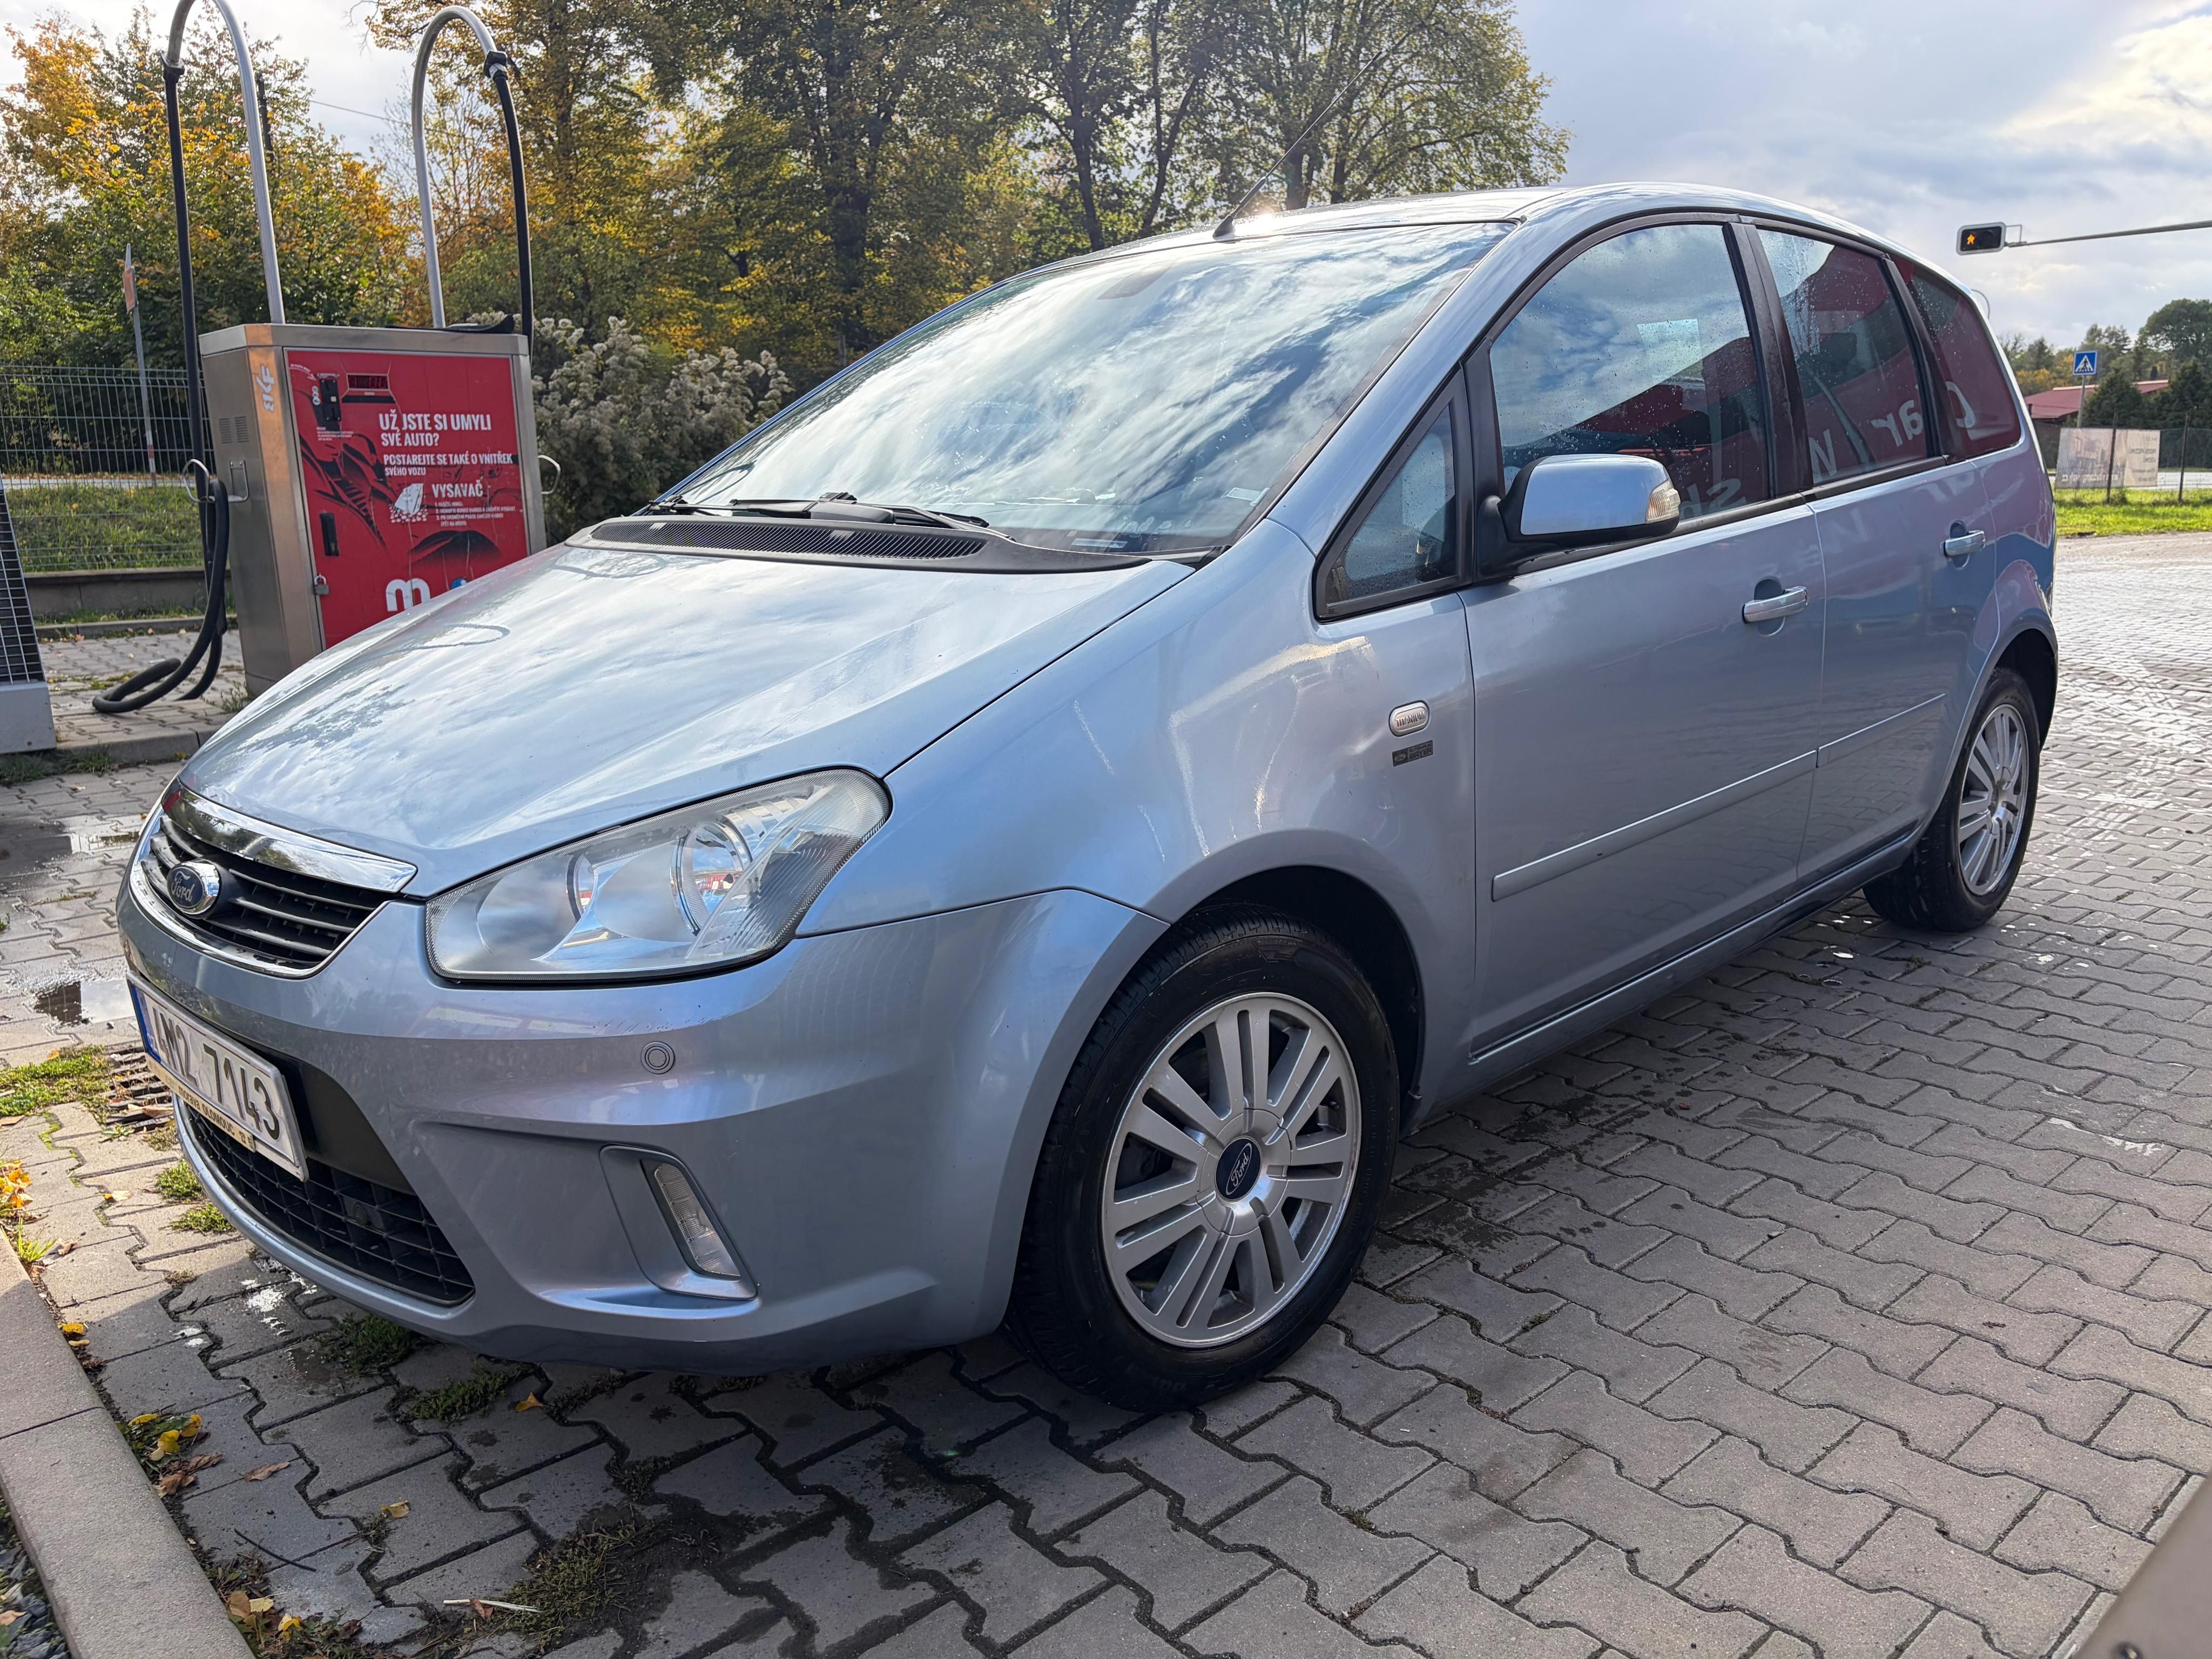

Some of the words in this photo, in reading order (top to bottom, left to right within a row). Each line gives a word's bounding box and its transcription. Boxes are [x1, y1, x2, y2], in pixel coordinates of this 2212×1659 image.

[379, 409, 399, 430] UŽ
[402, 413, 432, 430] JSTE
[434, 414, 448, 430] SI
[450, 414, 491, 430] UMYLI
[381, 429, 402, 446] SVÉ
[404, 433, 440, 447] AUTO?
[383, 454, 435, 466] POSTAREJTE
[437, 454, 448, 465] SE
[448, 450, 469, 465] TAKÉ
[471, 454, 478, 464] O
[479, 450, 514, 464] VNITŘEK
[385, 465, 407, 476] SVÉHO
[408, 467, 426, 476] VOZU
[432, 479, 484, 498] VYSAVAČ
[1395, 711, 1426, 727] TITANIUM
[171, 871, 195, 902] Ford
[203, 1042, 280, 1141] 7143
[202, 1103, 235, 1135] OLOMOUC
[1231, 1152, 1249, 1187] Ford
